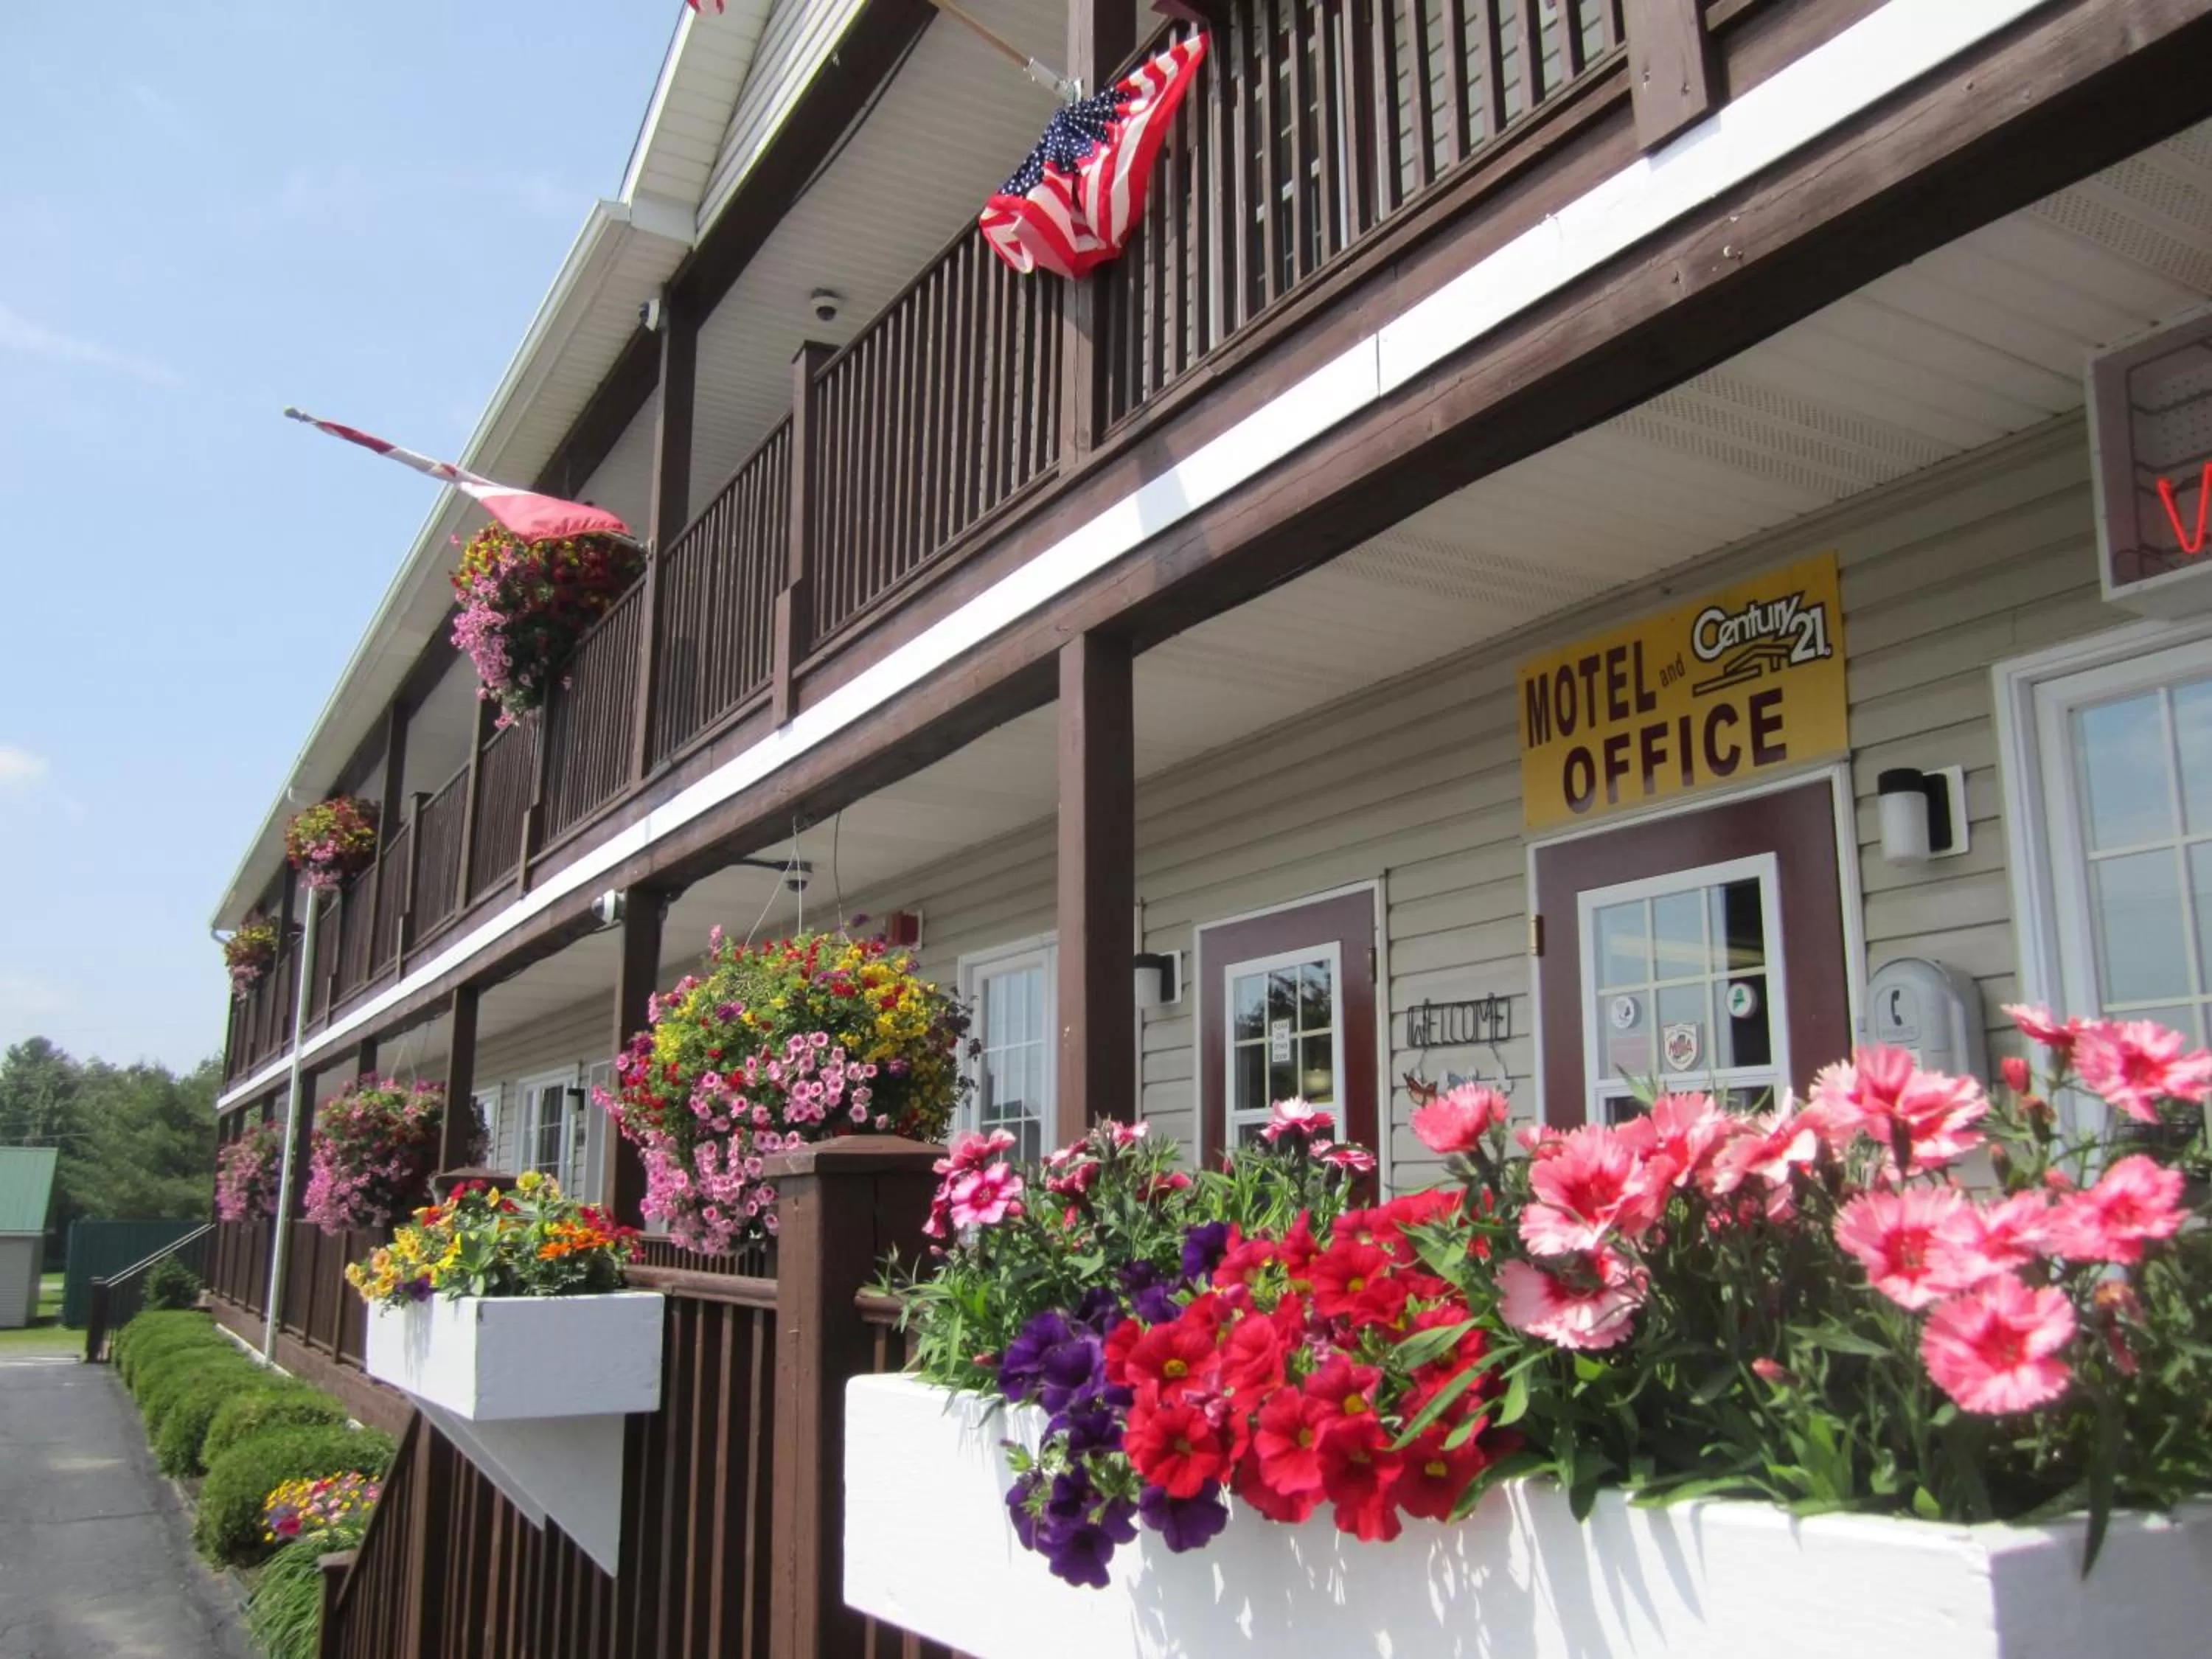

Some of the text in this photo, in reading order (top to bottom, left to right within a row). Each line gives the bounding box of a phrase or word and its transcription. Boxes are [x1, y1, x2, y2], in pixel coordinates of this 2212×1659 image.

[1526, 590, 1827, 748] MOTEL and Century 21
[1562, 687, 1787, 814] OFFICE
[1407, 997, 1511, 1048] WELCOME
